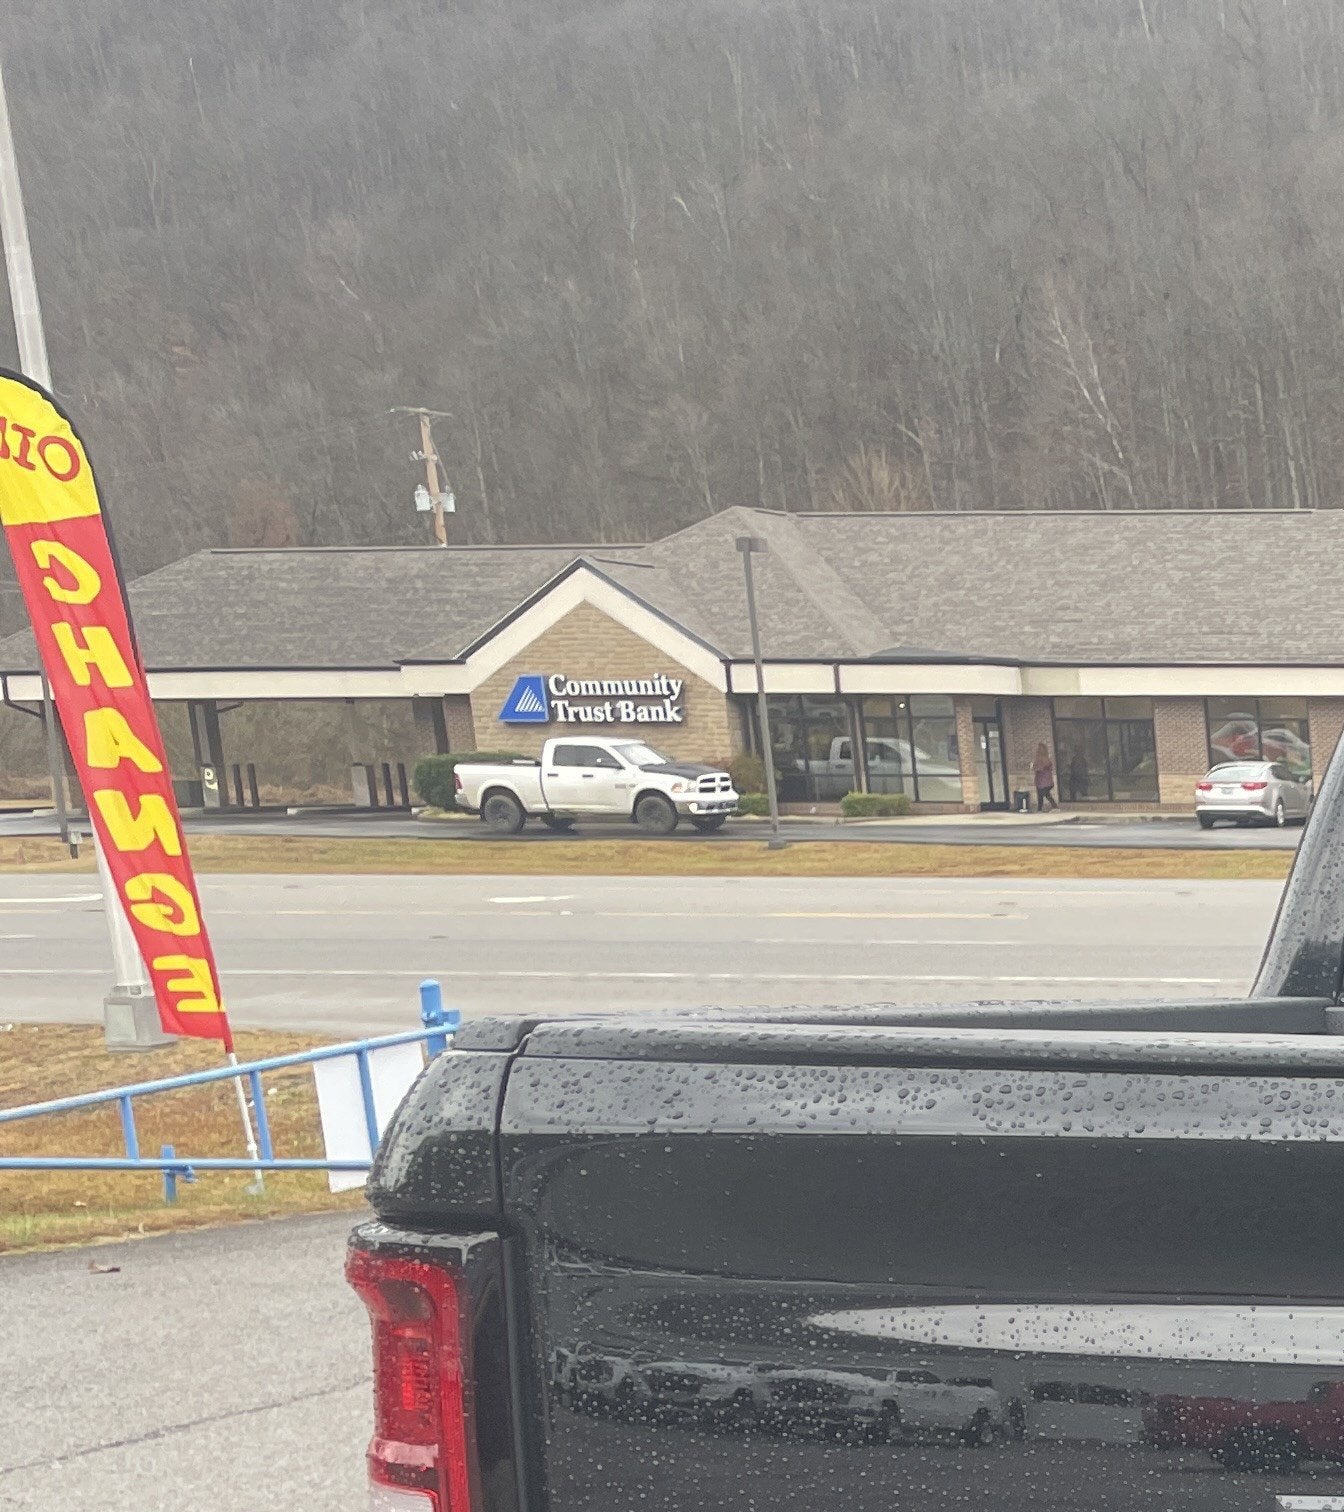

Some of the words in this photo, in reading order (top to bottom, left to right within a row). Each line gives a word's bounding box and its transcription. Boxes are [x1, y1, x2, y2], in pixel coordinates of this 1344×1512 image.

[549, 673, 682, 700] Community
[551, 700, 615, 722] Trust
[616, 699, 682, 722] Bank
